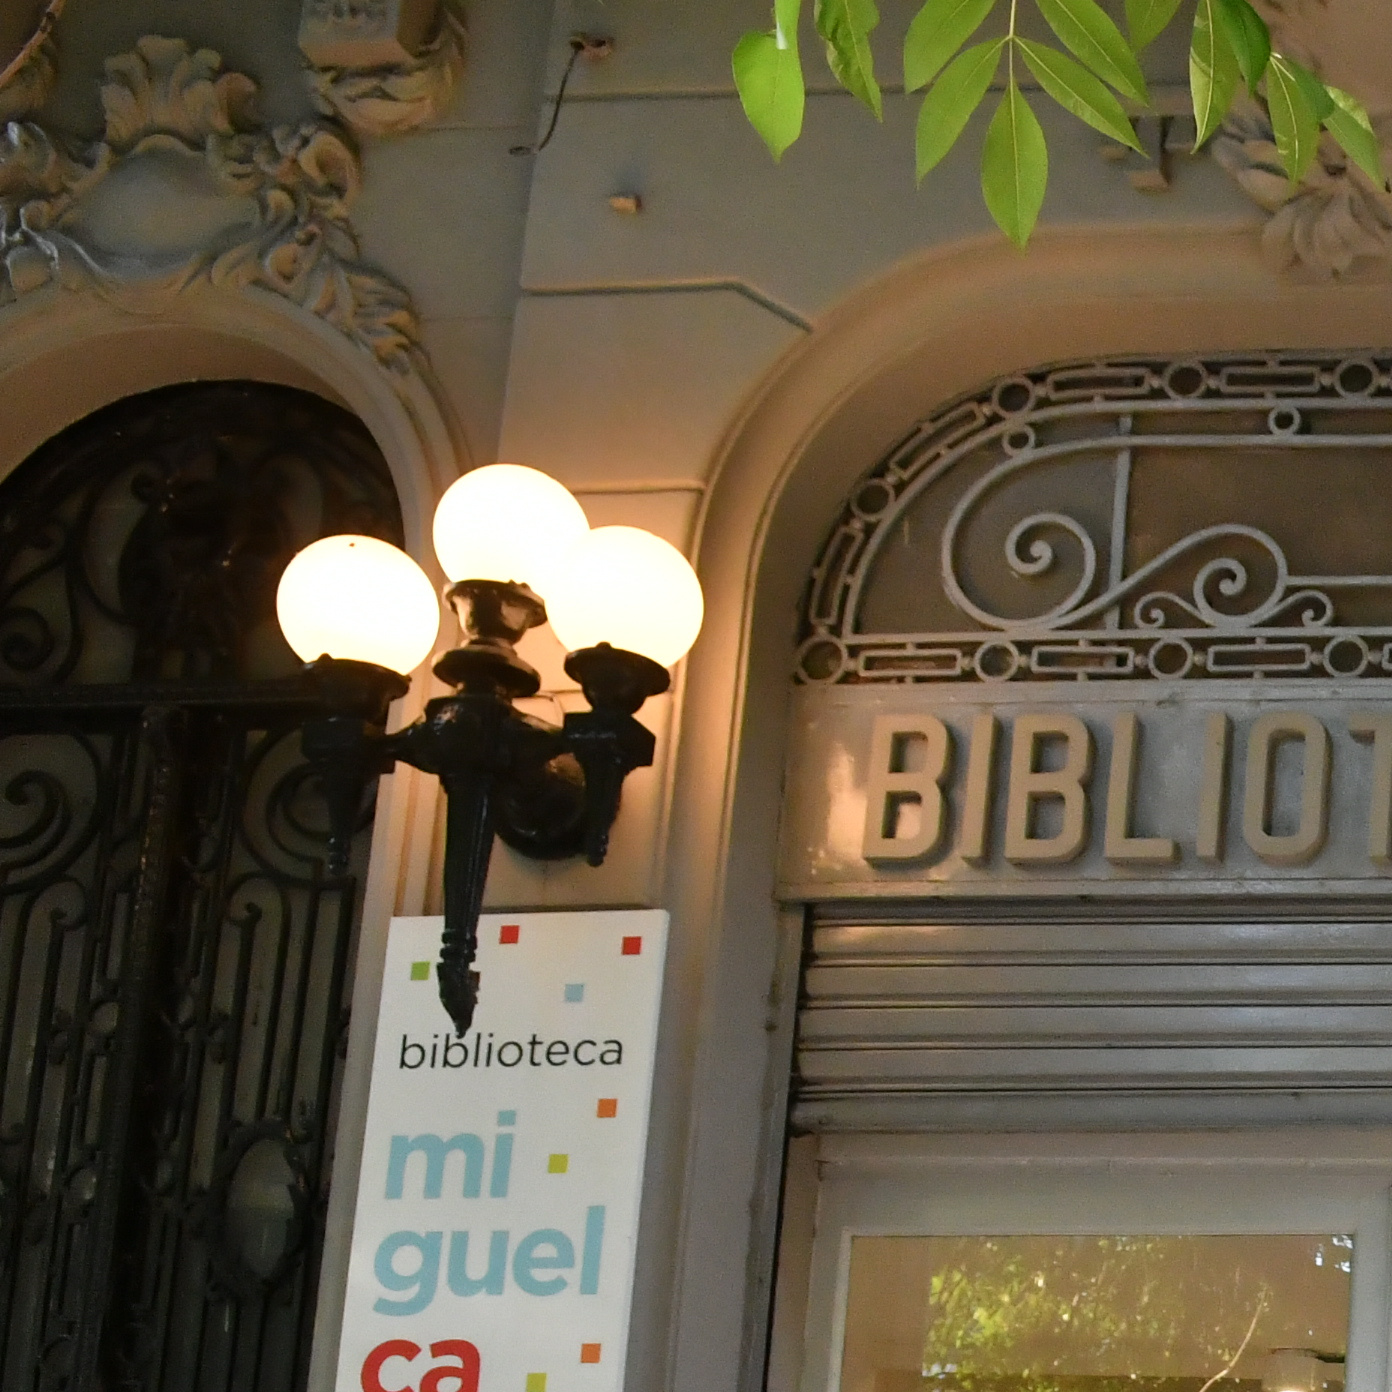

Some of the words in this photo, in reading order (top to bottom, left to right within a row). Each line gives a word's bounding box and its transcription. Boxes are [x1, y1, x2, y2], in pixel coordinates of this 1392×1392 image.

[399, 1032, 623, 1069] biblioteca
[384, 1109, 517, 1200] mi
[372, 1204, 606, 1317] guel
